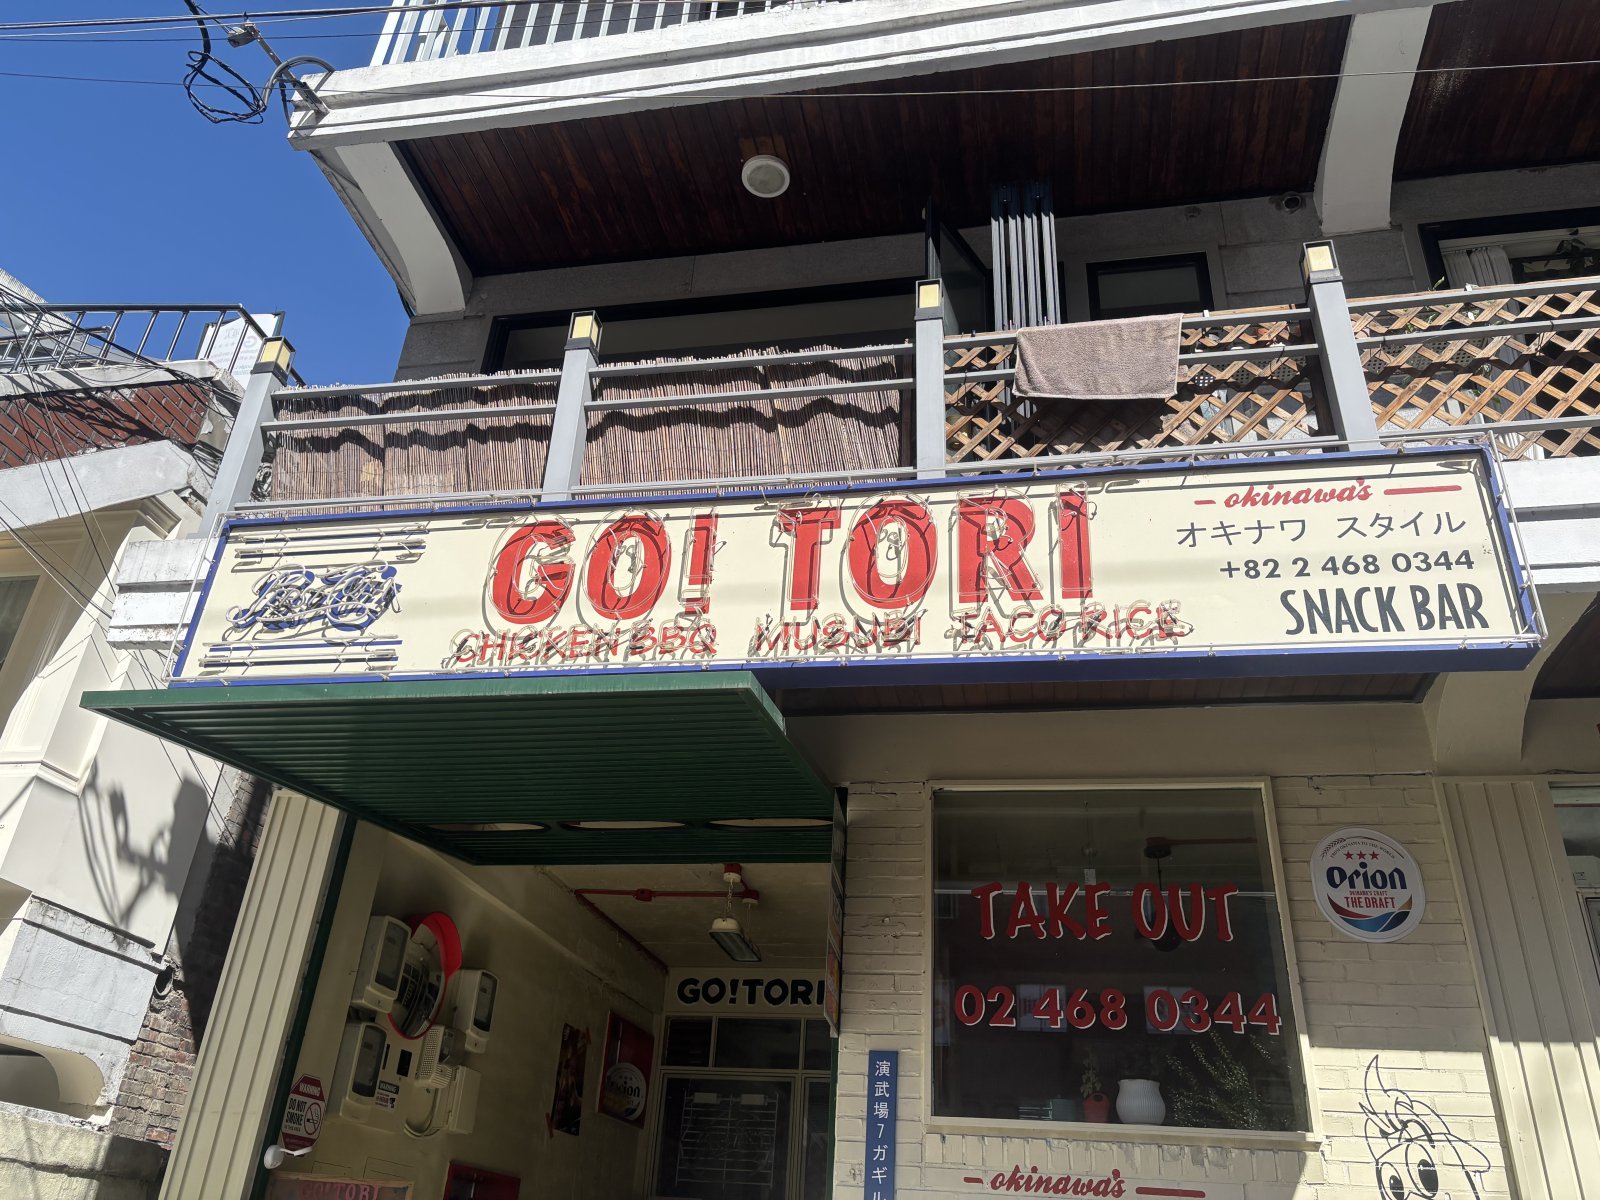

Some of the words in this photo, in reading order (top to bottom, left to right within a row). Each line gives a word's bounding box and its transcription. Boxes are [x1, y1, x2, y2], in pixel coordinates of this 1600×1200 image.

[1223, 478, 1373, 508] okinawa's
[1176, 518, 1307, 548] オキナワ
[1336, 511, 1467, 540] スタイル
[488, 508, 719, 625] GO!
[777, 488, 1095, 611] TORI
[1219, 558, 1282, 580] +82
[1291, 557, 1311, 578] 2
[1321, 554, 1381, 577] 468
[1391, 549, 1475, 573] 0344
[1280, 586, 1406, 636] SNACK
[1410, 582, 1490, 632] BAR
[453, 625, 619, 662] CHICKEN
[630, 622, 718, 656] BBQ
[955, 608, 1067, 645] TACO
[1081, 603, 1187, 640] RICE
[1325, 861, 1408, 890] Orion
[971, 880, 1113, 941] TAKE
[1131, 881, 1239, 942] OUT
[1344, 896, 1364, 909] THE
[1364, 896, 1396, 909] DRAFT
[954, 984, 1017, 1028] 02
[1033, 987, 1128, 1031] 468
[1146, 988, 1282, 1036] 0344
[288, 1098, 297, 1112] DO
[296, 1101, 308, 1114] NOT
[299, 1082, 321, 1097] WARNING
[285, 1111, 305, 1127] SMOKE
[990, 1164, 1127, 1199] okinawa's
